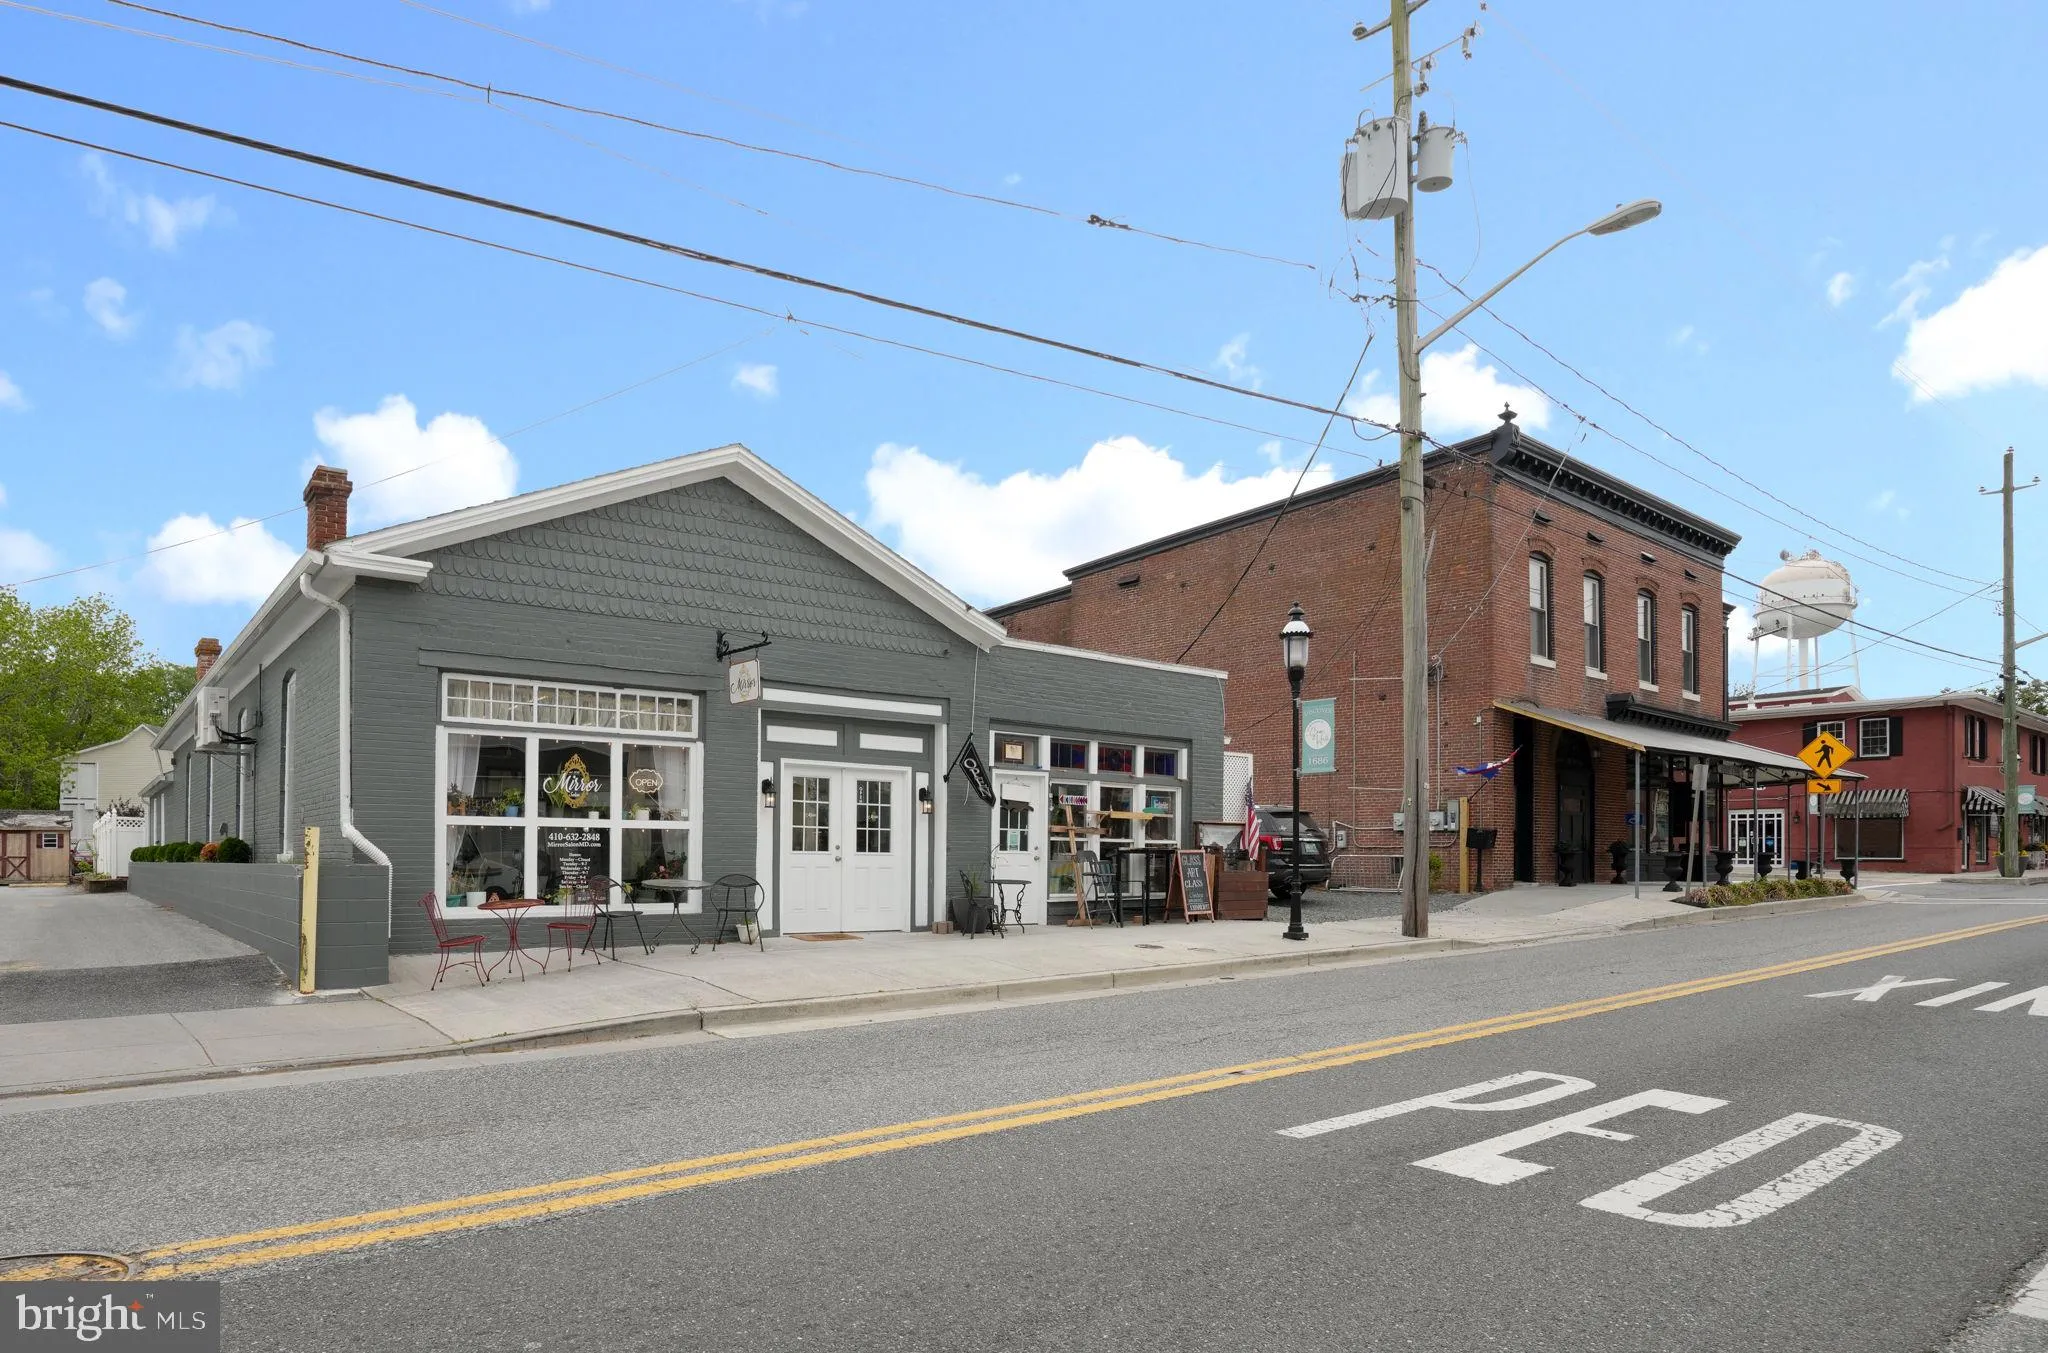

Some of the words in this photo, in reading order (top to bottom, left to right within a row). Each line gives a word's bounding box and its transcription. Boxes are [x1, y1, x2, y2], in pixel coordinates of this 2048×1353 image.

[1307, 756, 1329, 766] 1686
[542, 772, 602, 794] Mirror
[635, 778, 658, 787] OPEN
[963, 758, 993, 799] OPEN
[548, 832, 600, 841] 410-632-2848
[1181, 854, 1202, 866] GLASS
[1186, 867, 1200, 878] ART
[1184, 879, 1204, 888] CLASS
[1274, 1070, 1904, 1228] PED
